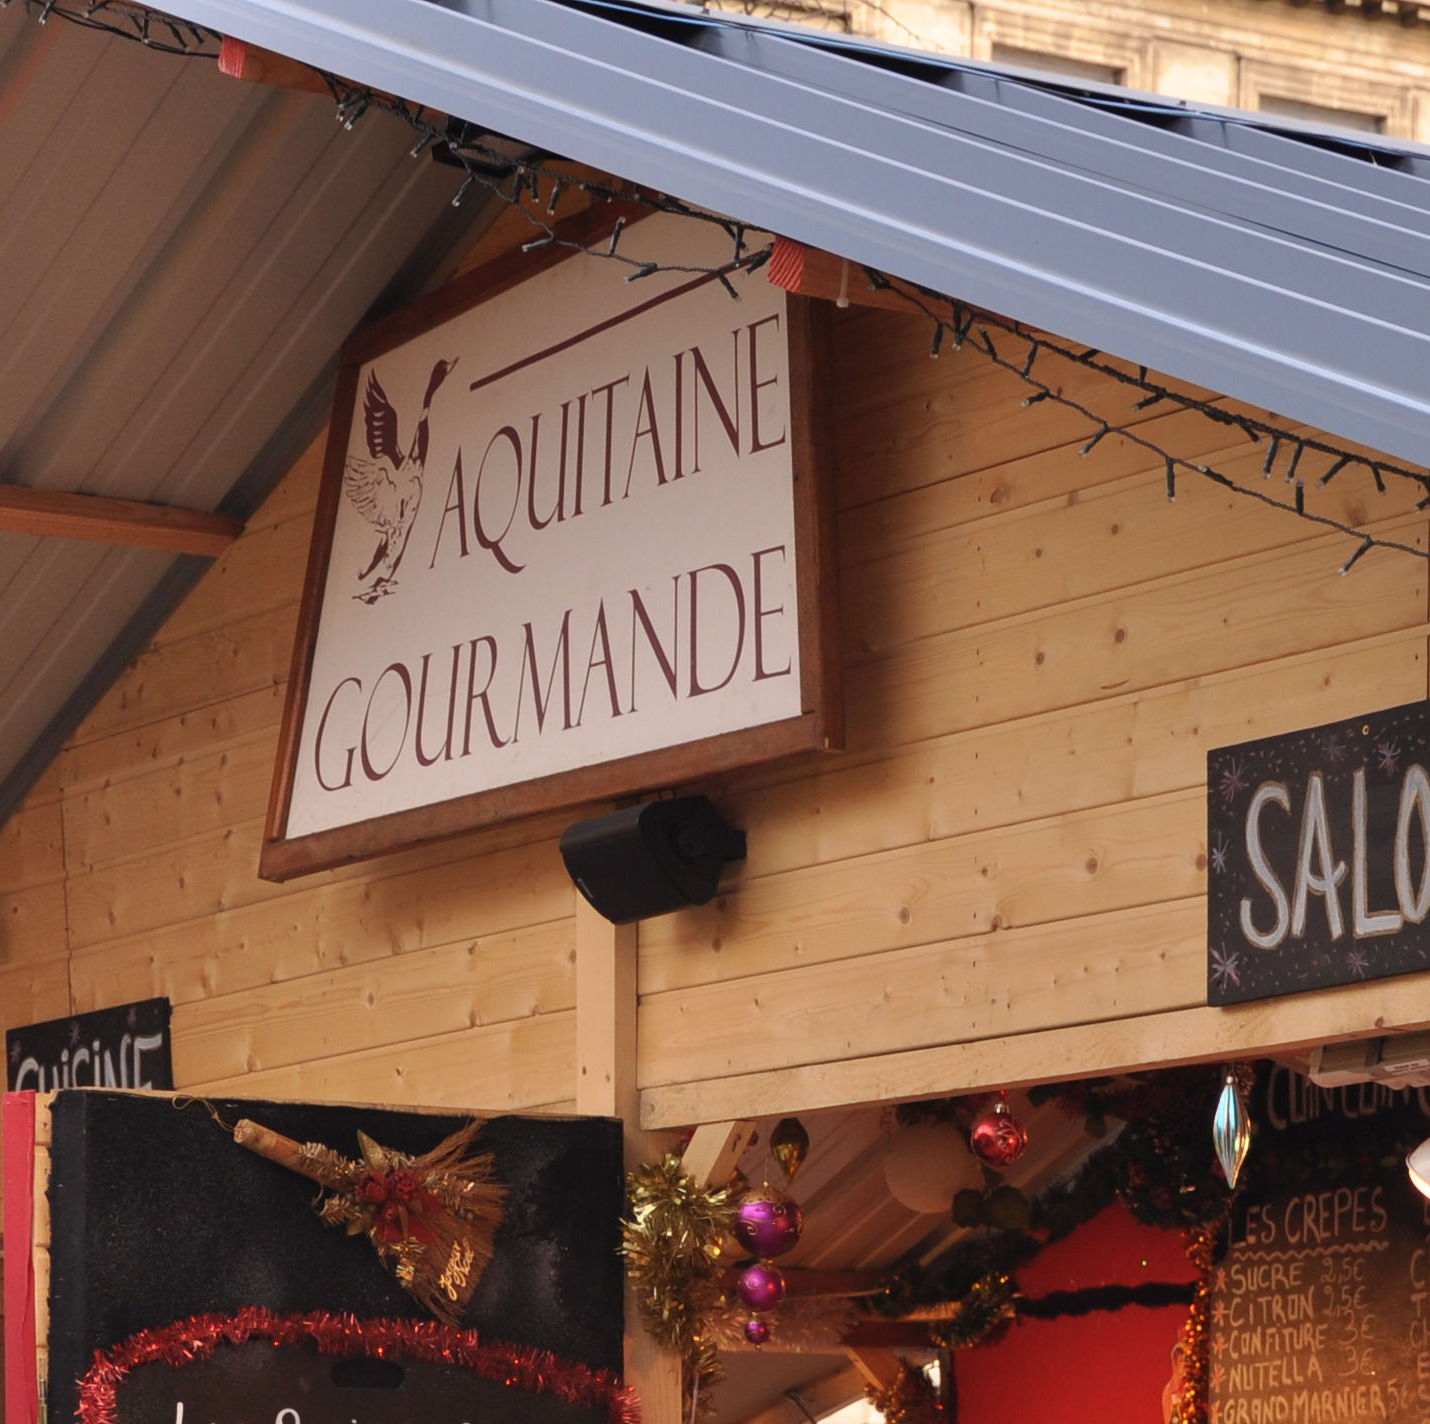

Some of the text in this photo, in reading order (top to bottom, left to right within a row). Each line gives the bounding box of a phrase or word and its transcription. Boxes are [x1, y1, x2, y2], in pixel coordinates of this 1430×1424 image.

[429, 313, 786, 574] AQUITAINE
[314, 544, 792, 792] GOURMANDE
[1285, 1186, 1387, 1244] CREPES
[1230, 1262, 1305, 1295] SUCRE
[1339, 1311, 1376, 1345] 3€
[1228, 1346, 1375, 1393] NUTELLA 3€
